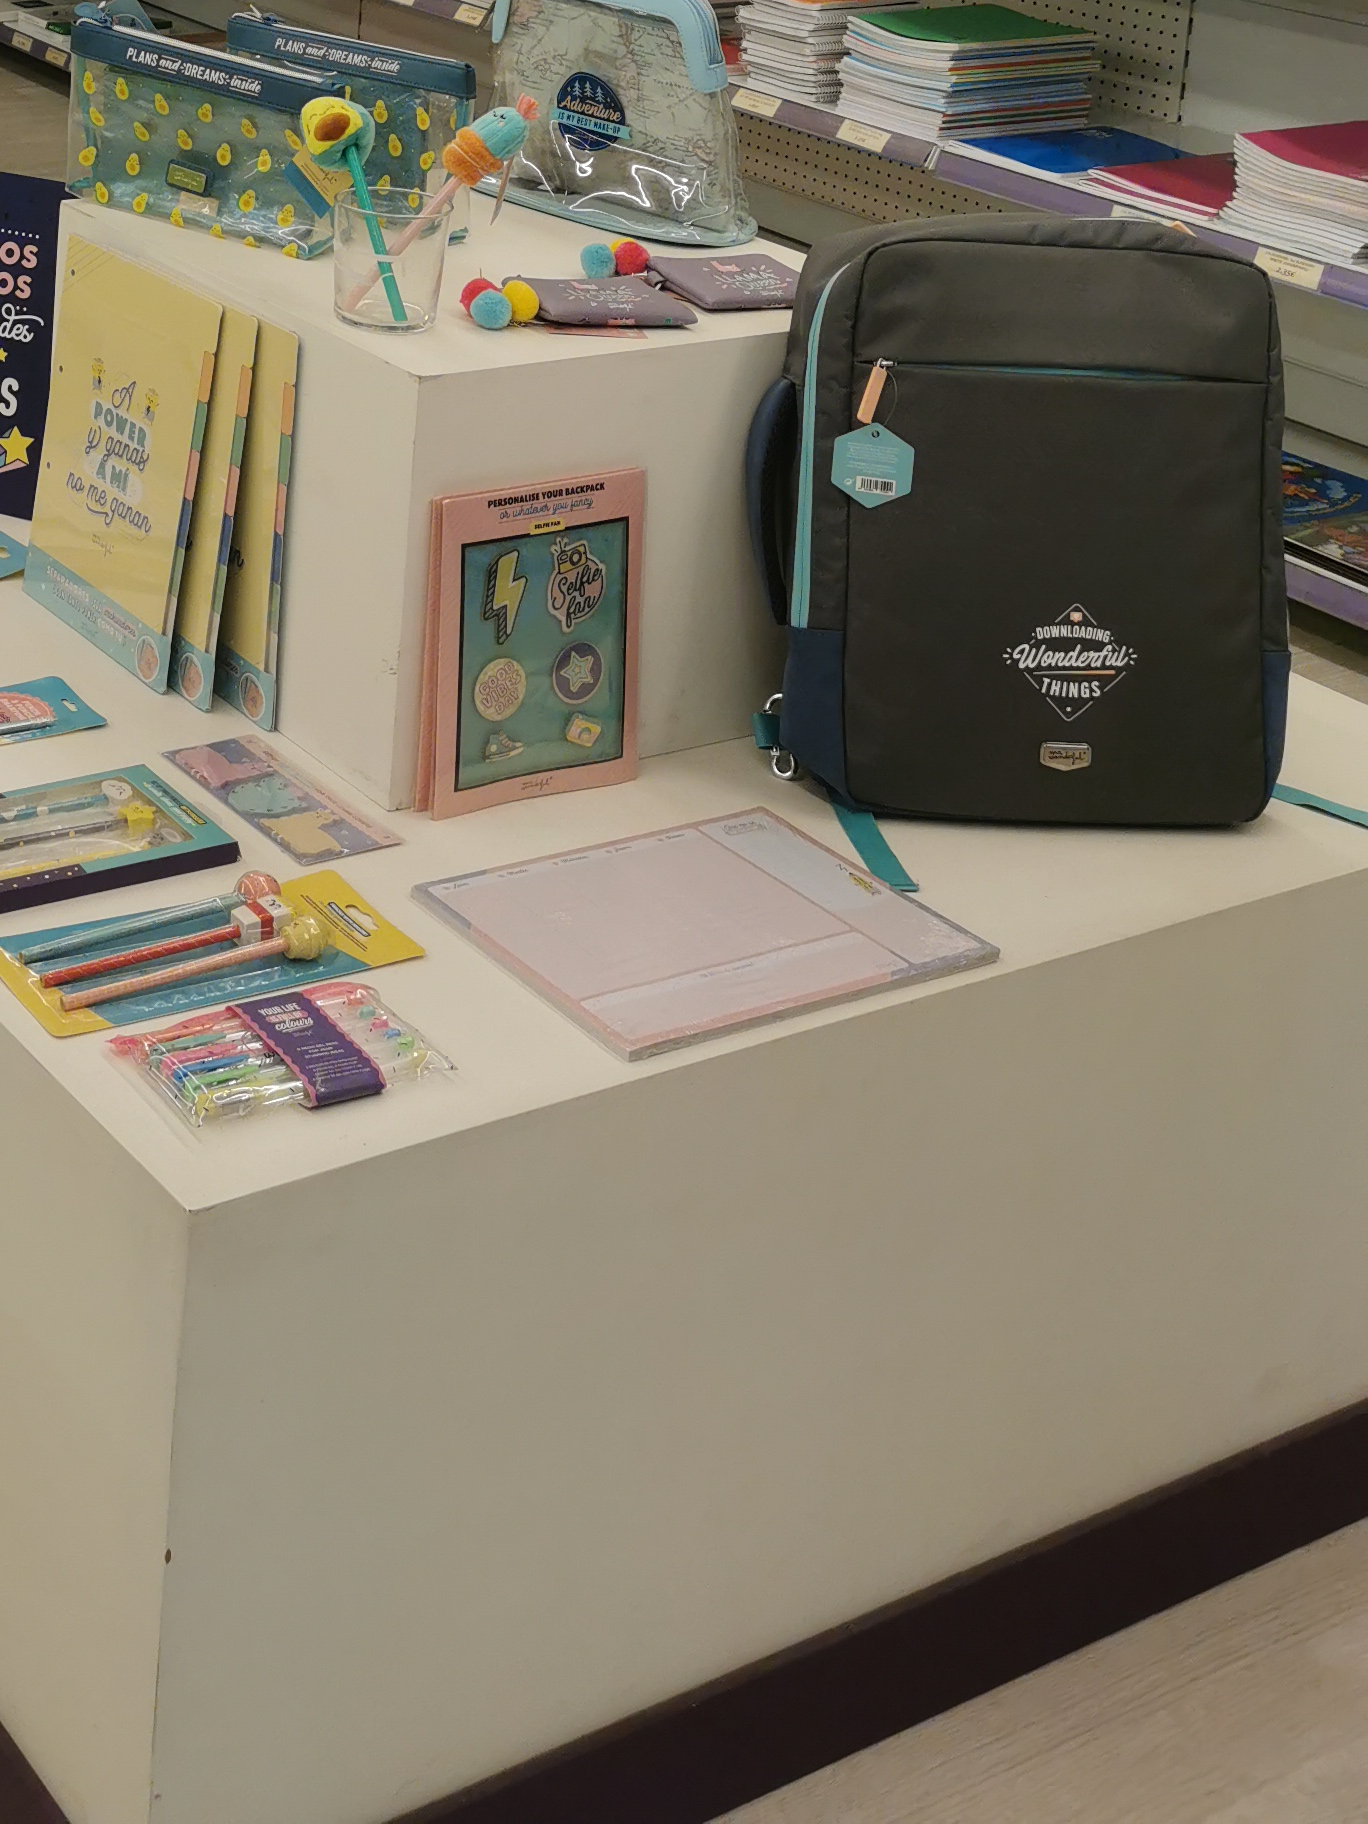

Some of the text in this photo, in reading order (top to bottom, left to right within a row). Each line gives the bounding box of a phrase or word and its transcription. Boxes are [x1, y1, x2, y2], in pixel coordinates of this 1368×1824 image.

[126, 47, 263, 96] PLANS and DREAMS inside
[274, 38, 402, 75] PLANS and DREAMS inside
[559, 95, 622, 122] Adventure
[93, 400, 148, 448] POWER
[102, 435, 150, 472] ganas
[66, 471, 152, 534] no me ganan
[487, 482, 605, 509] PERSONALISE YOUR BACKPACK
[500, 496, 594, 520] or whatever you fancy
[551, 564, 602, 611] Selfie
[565, 595, 596, 629] fan
[1035, 624, 1112, 643] DOWNLOADING
[1012, 643, 1129, 669] Wonderful
[478, 660, 515, 695] GOOD
[481, 671, 522, 709] VIBES
[1041, 677, 1101, 698] THINGS
[495, 688, 521, 715] DAY
[257, 1002, 301, 1017] YOUR LIFE
[275, 1016, 314, 1031] colours
